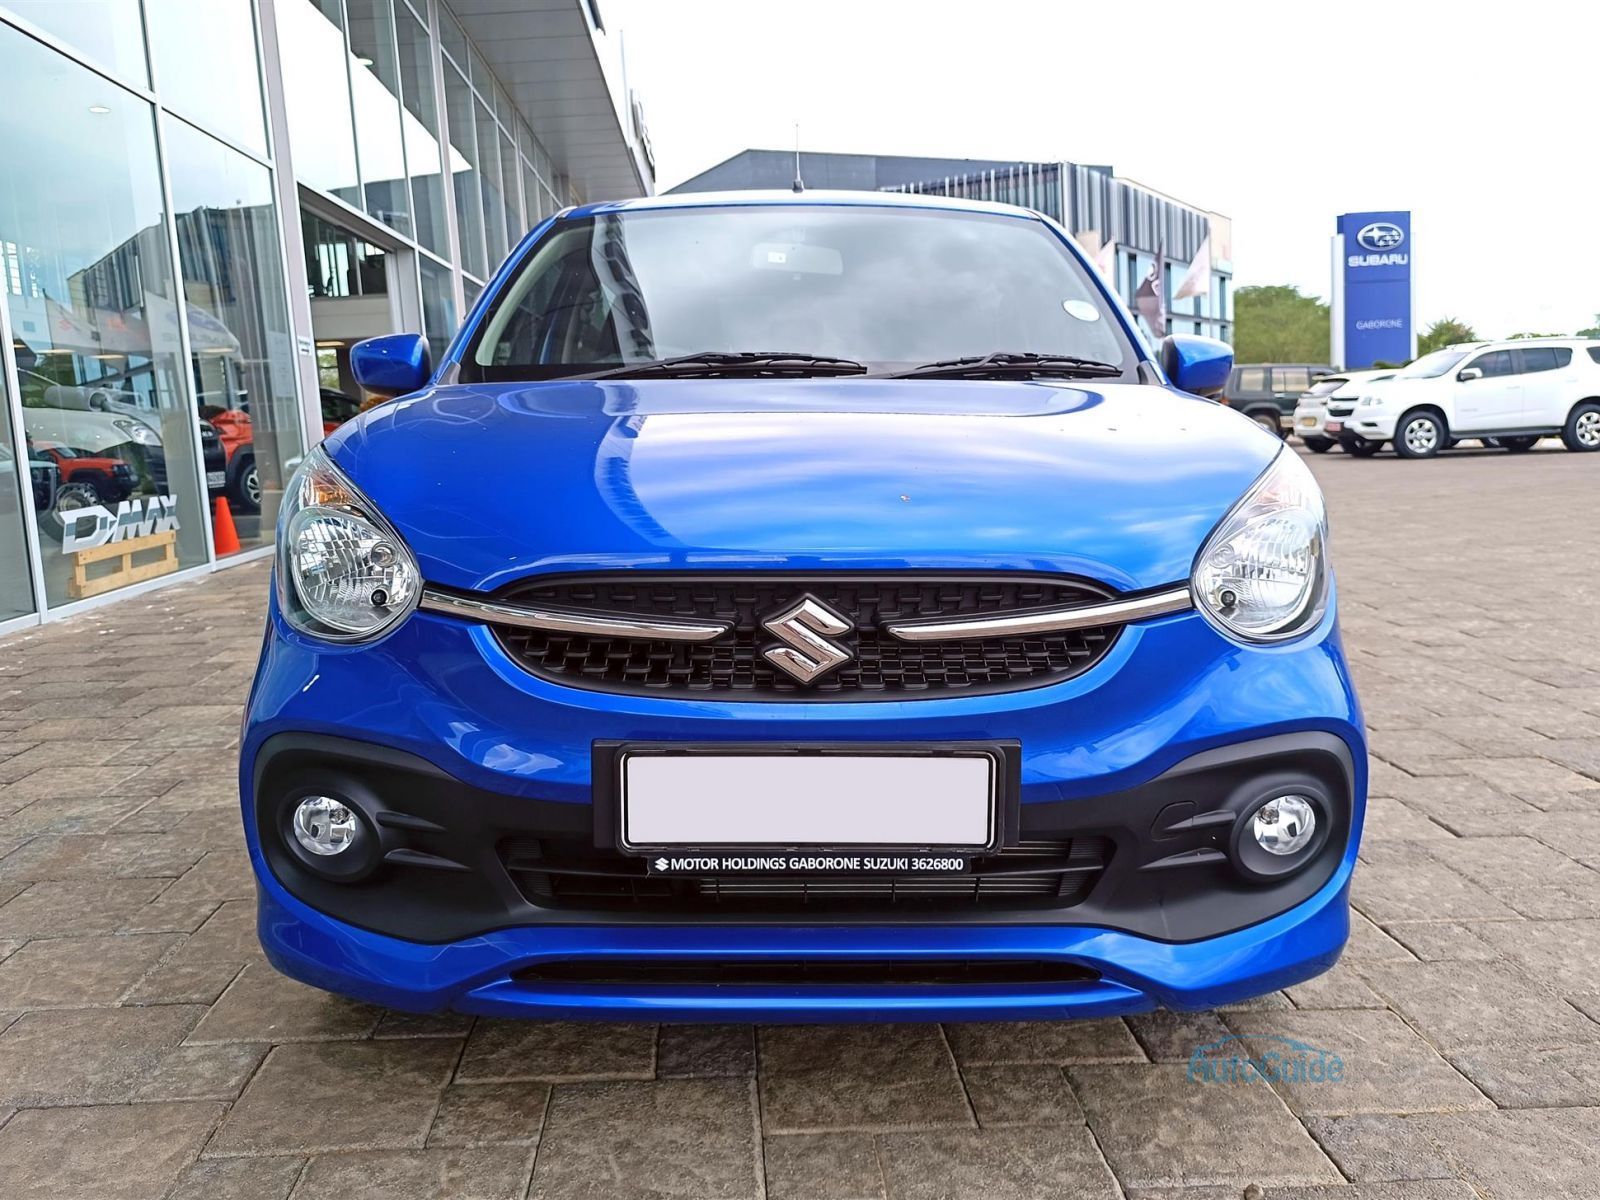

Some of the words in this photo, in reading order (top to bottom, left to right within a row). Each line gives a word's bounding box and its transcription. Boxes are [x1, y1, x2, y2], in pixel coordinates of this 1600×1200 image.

[1348, 254, 1408, 267] SUBARU
[1355, 319, 1403, 330] GABORONE
[671, 857, 719, 870] MOTOR
[722, 857, 786, 870] HOLDINGS
[789, 857, 861, 870] GABORONE
[863, 857, 908, 870] SUZUKI
[911, 857, 964, 871] 3626800
